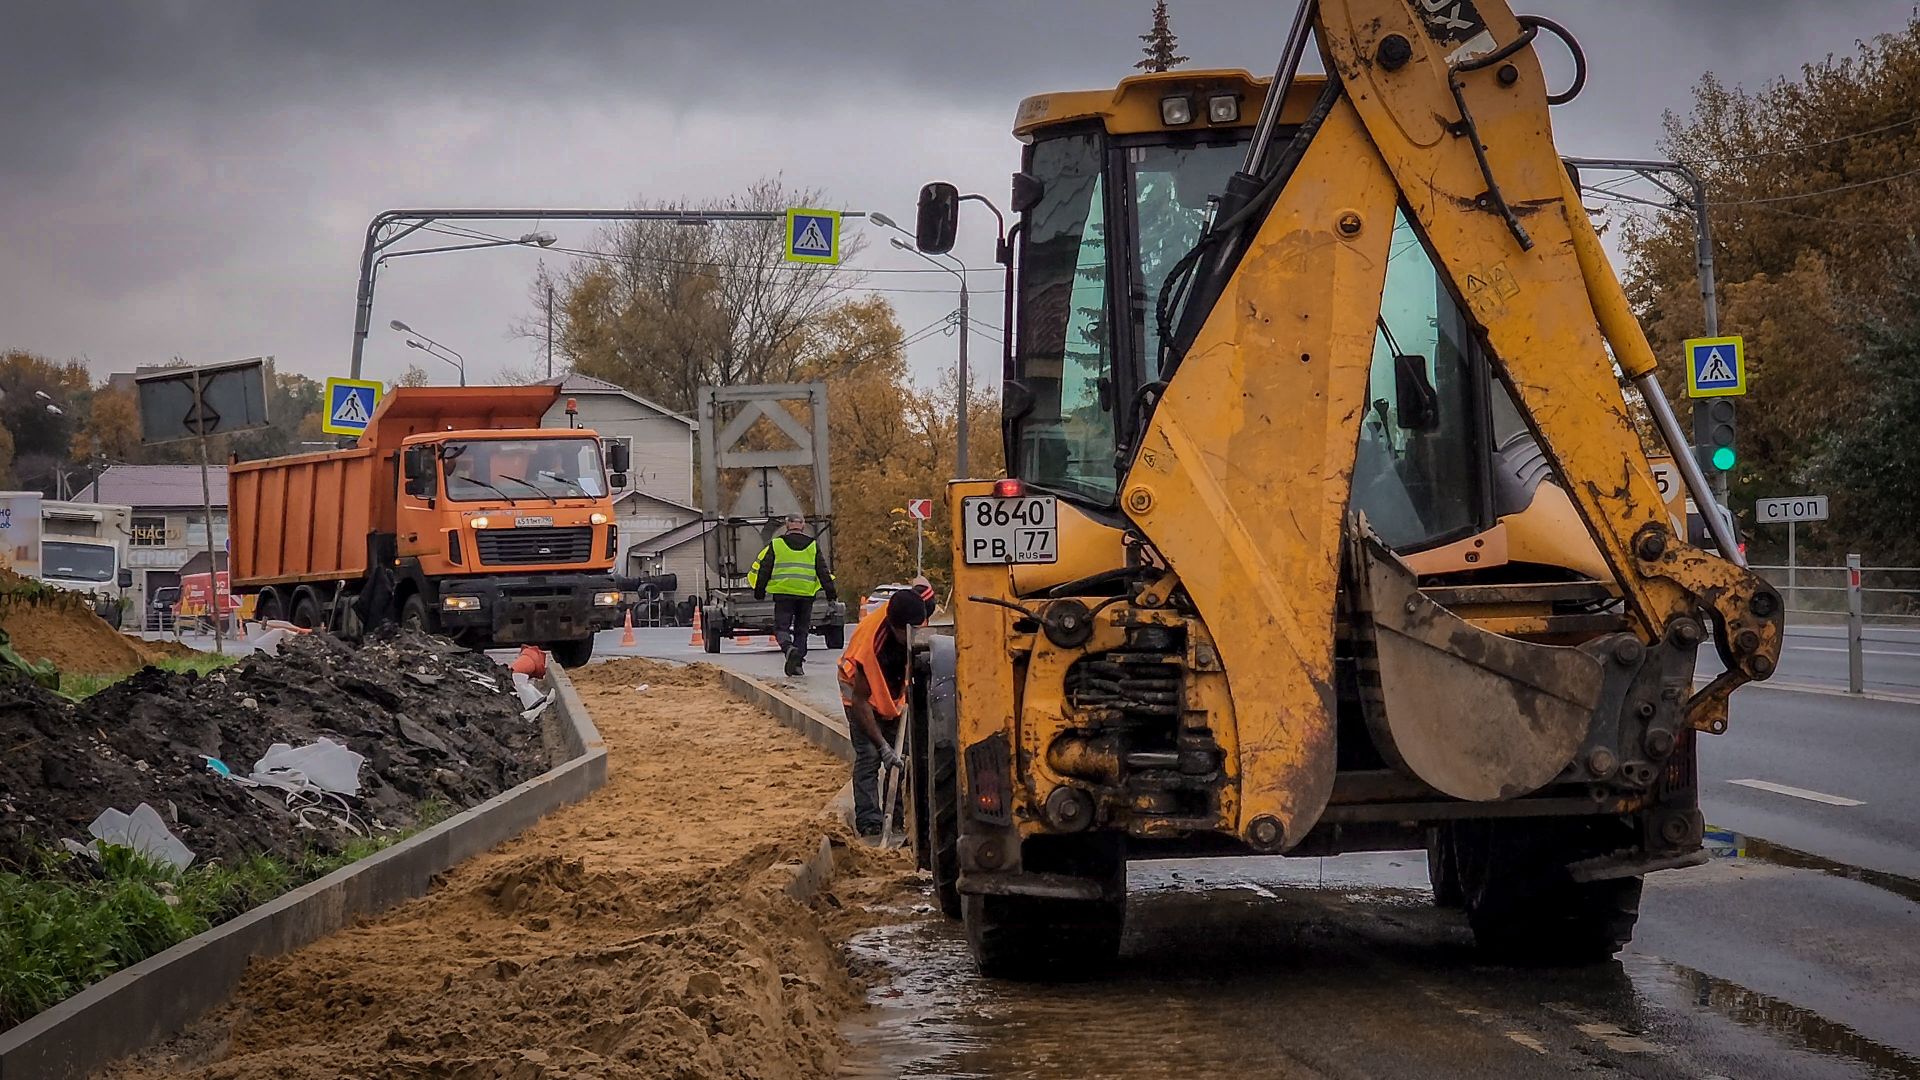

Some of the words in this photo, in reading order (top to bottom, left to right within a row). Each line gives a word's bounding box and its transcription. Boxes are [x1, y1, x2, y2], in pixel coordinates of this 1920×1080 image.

[977, 500, 1044, 526] 8640
[1767, 501, 1818, 518] СТОП
[973, 538, 1006, 558] РВ
[1024, 531, 1049, 551] 77
[1018, 552, 1039, 560] RUS
